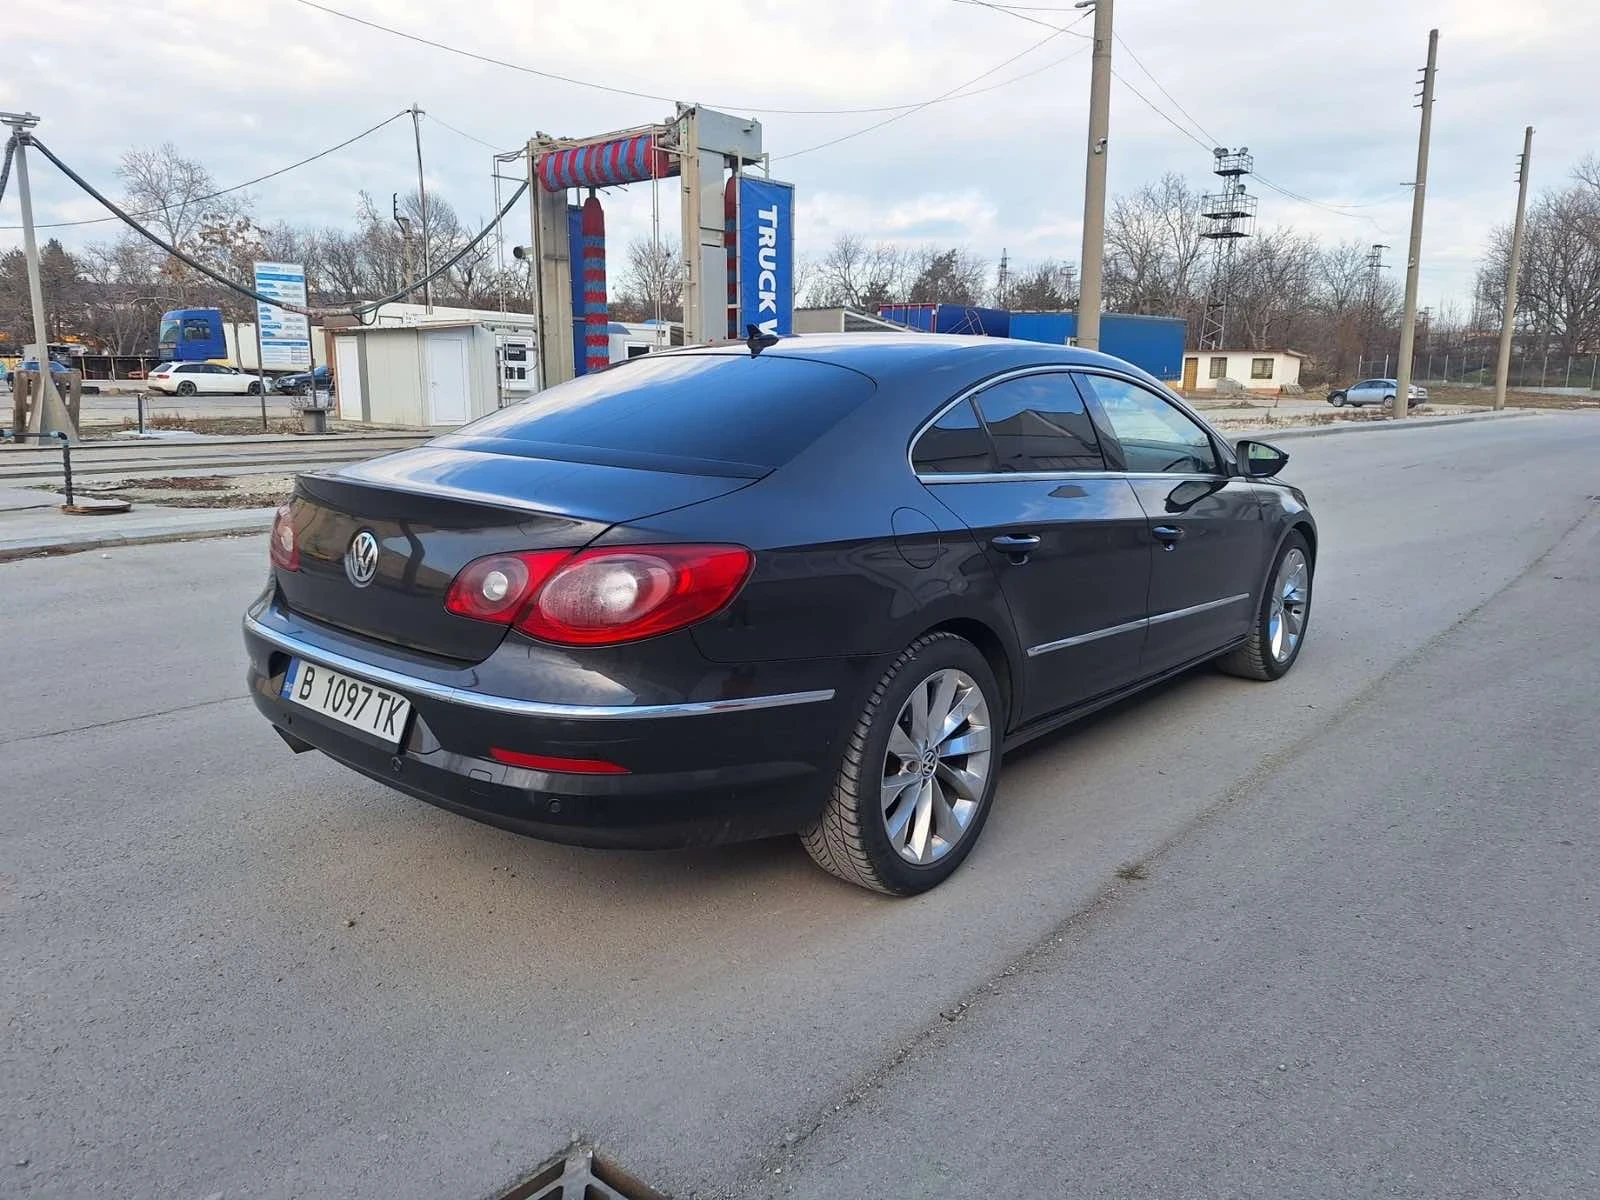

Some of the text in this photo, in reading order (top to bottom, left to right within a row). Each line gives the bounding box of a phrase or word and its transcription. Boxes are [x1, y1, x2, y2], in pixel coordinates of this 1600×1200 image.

[758, 204, 778, 314] TRUCK
[299, 666, 406, 736] B 1097 TK
